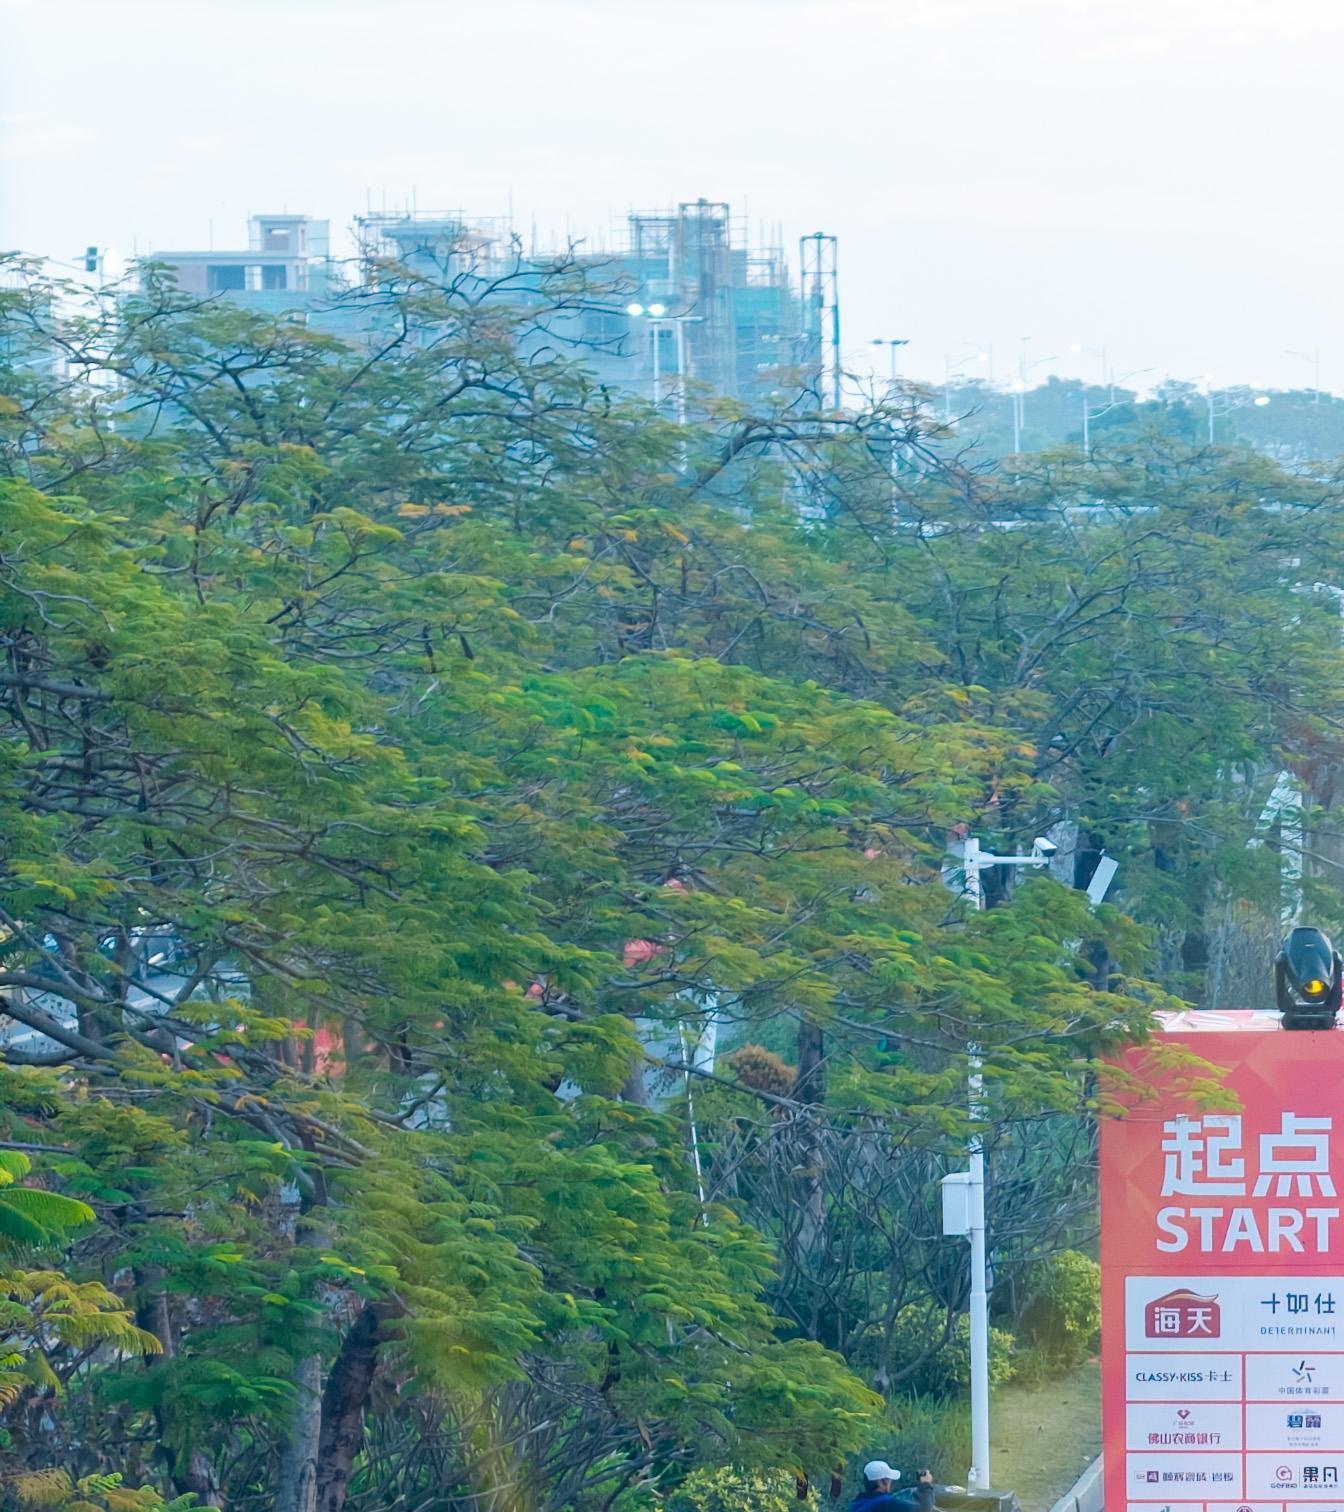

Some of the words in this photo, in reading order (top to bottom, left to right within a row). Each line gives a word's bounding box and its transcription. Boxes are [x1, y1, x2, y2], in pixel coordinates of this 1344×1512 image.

[1160, 1112, 1337, 1197] 起点
[1156, 1207, 1340, 1252] START
[1154, 1306, 1213, 1334] 海天
[1260, 1326, 1336, 1336] DETERMINANT
[1204, 1370, 1233, 1382] 卡士
[1148, 1432, 1221, 1445] 佛山农商银行
